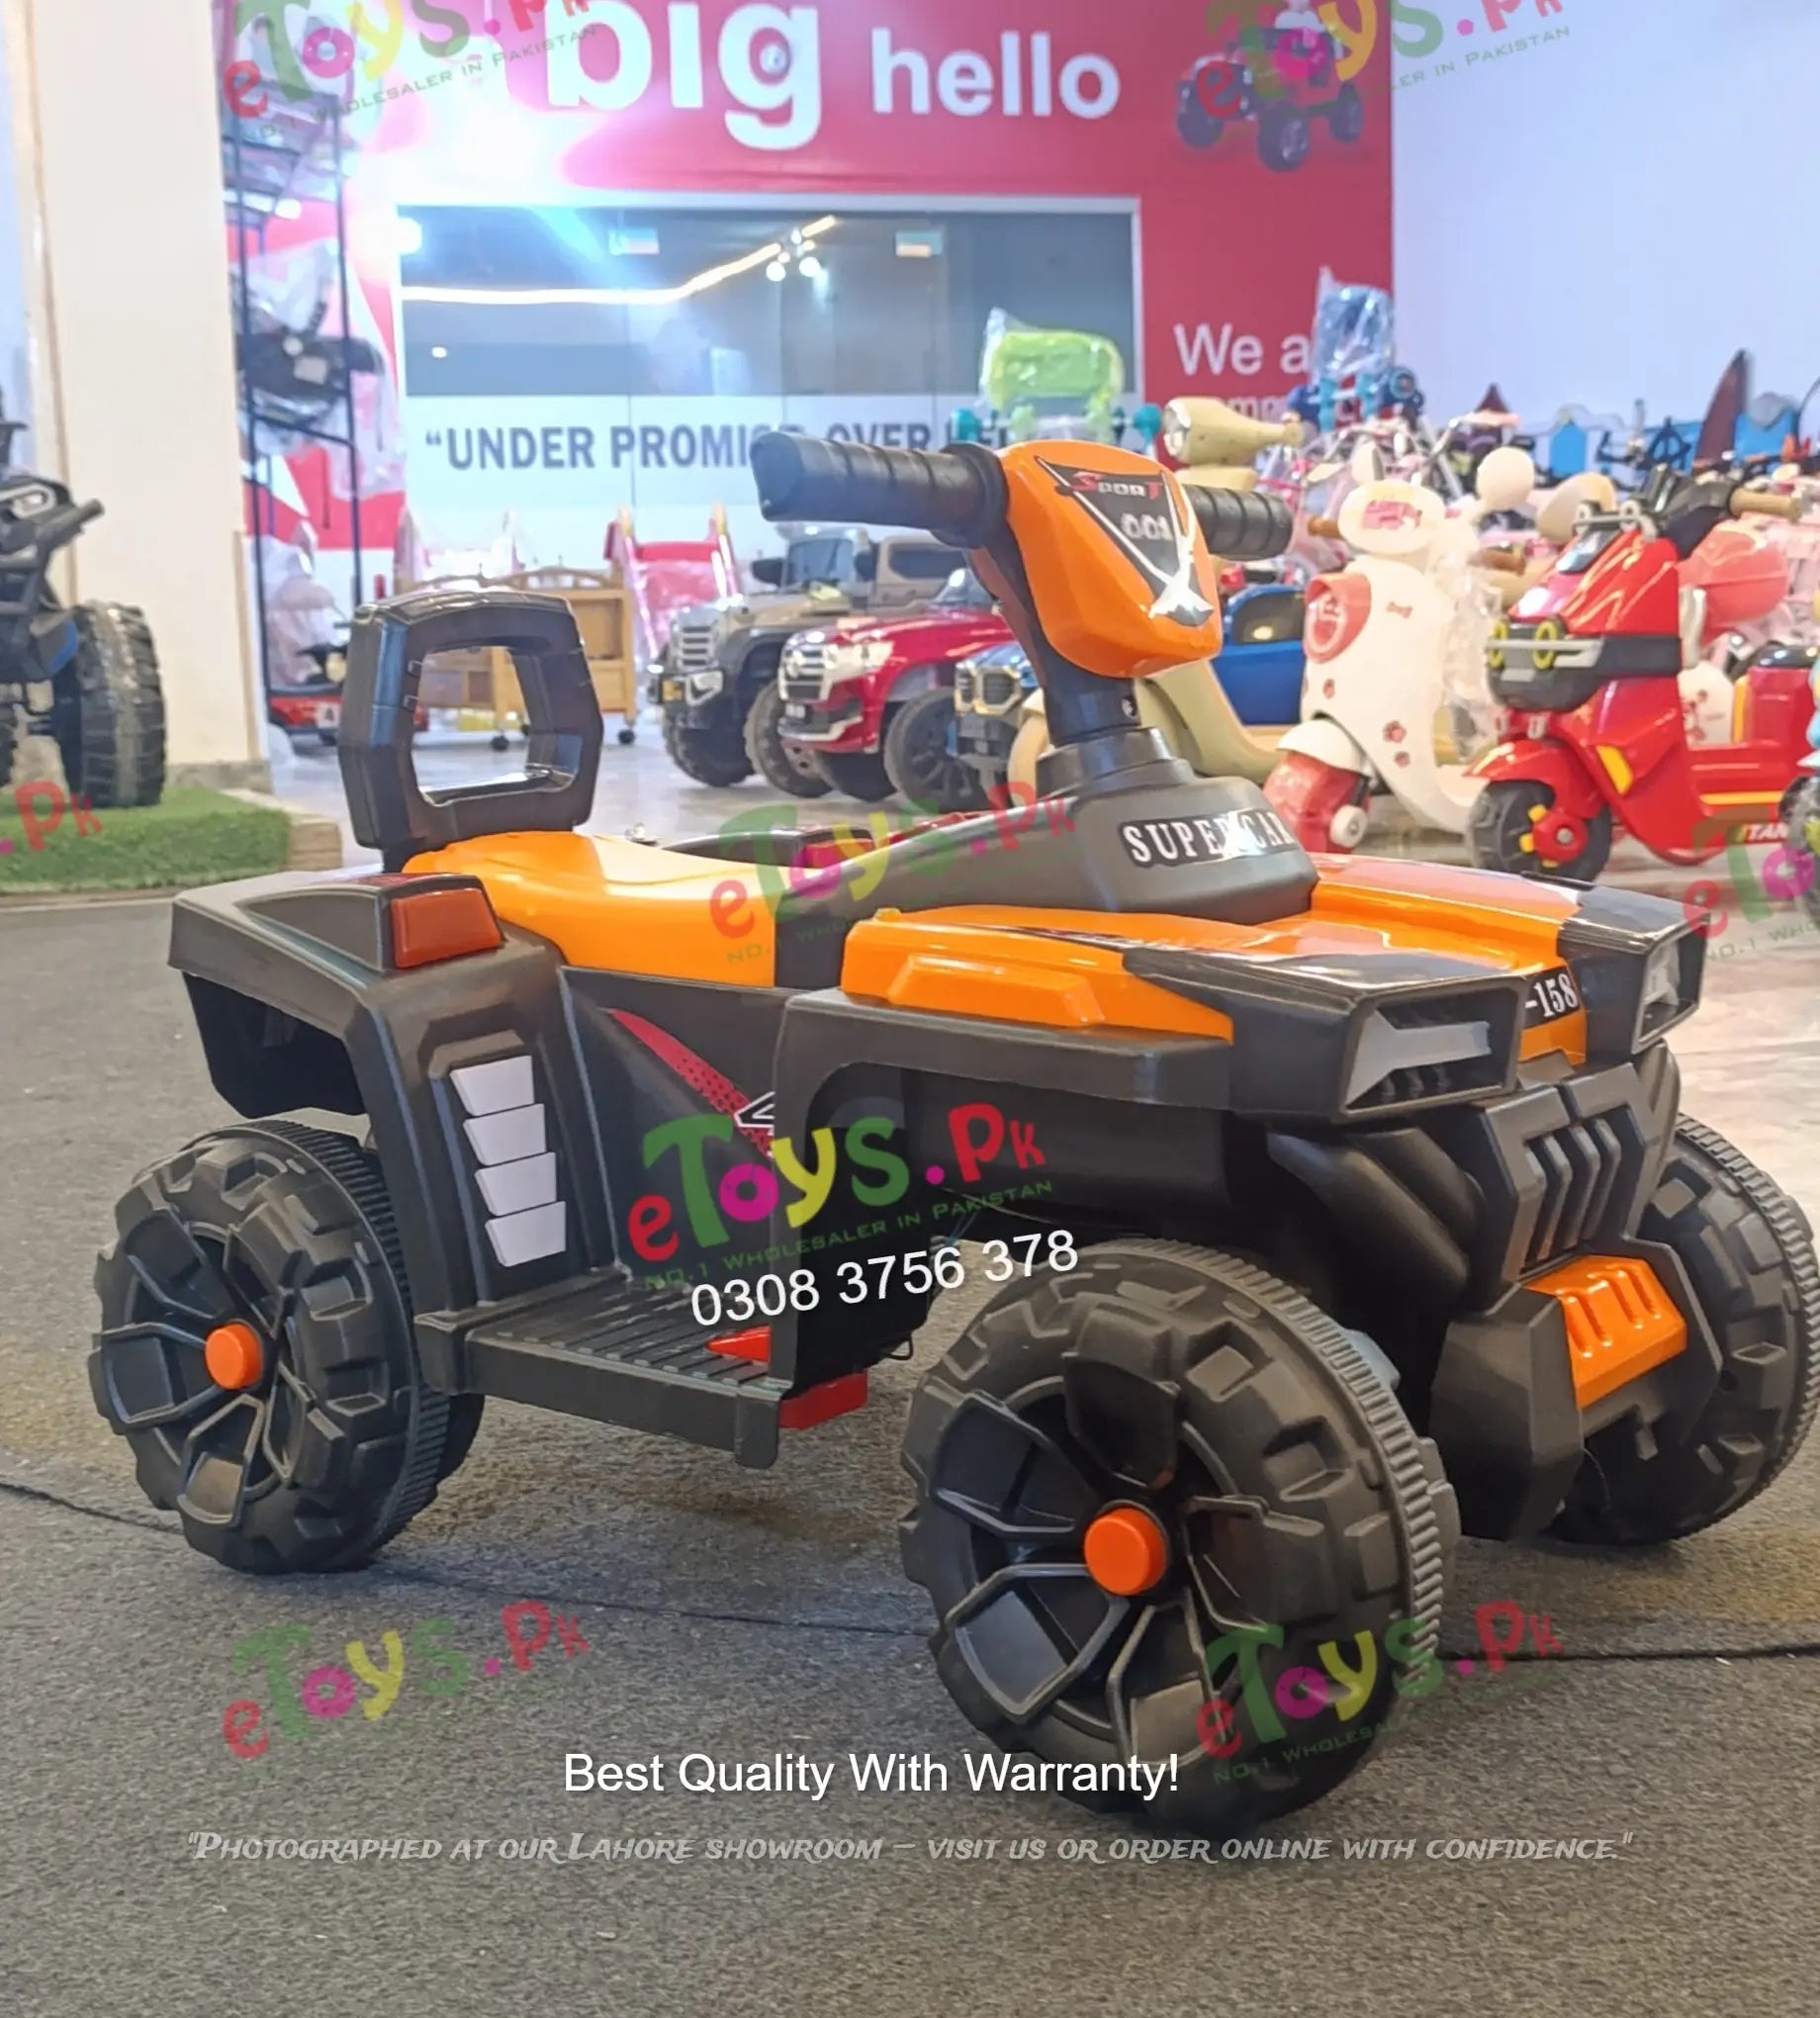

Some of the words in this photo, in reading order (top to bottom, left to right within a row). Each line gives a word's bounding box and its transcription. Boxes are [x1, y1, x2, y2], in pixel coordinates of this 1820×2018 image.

[548, 0, 822, 150] big
[871, 27, 1121, 119] hello
[1173, 322, 1264, 376] We
[610, 424, 805, 470] PROMI
